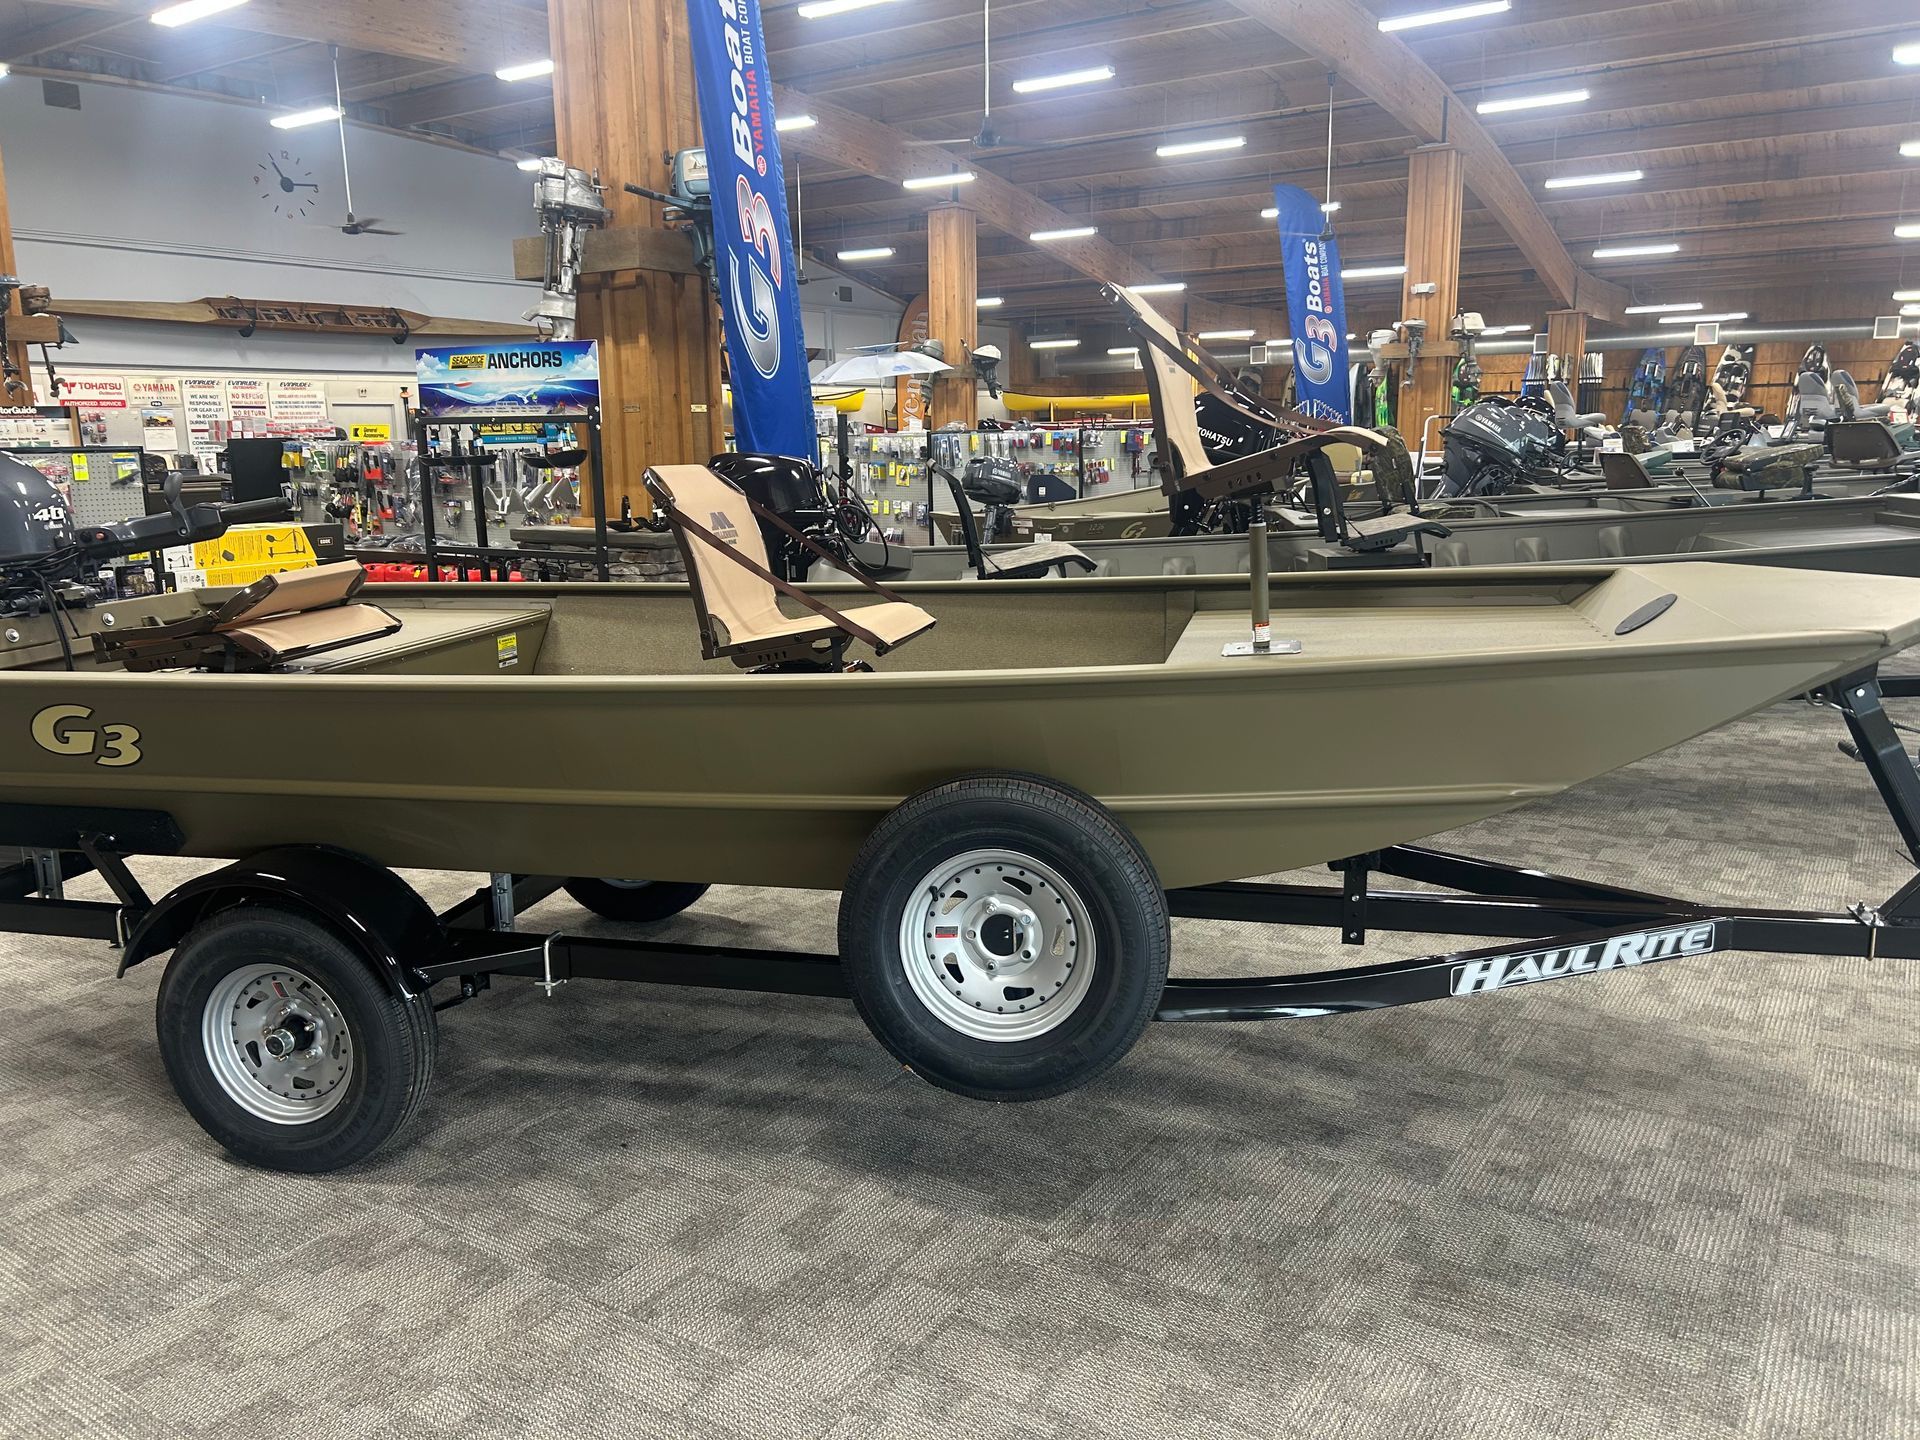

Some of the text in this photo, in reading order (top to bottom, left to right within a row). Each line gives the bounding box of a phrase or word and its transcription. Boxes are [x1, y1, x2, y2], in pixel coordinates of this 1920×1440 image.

[740, 28, 754, 64] BOAT
[745, 69, 764, 153] YAMAHA
[728, 173, 782, 380] G3
[1303, 241, 1323, 313] Boats
[451, 351, 563, 369] SEACHOICE ANCHORS
[1295, 315, 1337, 385] G3
[78, 383, 122, 391] TOHATSU
[142, 383, 175, 392] YAMAHA
[1197, 426, 1234, 448] TOHATSU
[33, 507, 65, 521] 40
[31, 703, 143, 767] G3
